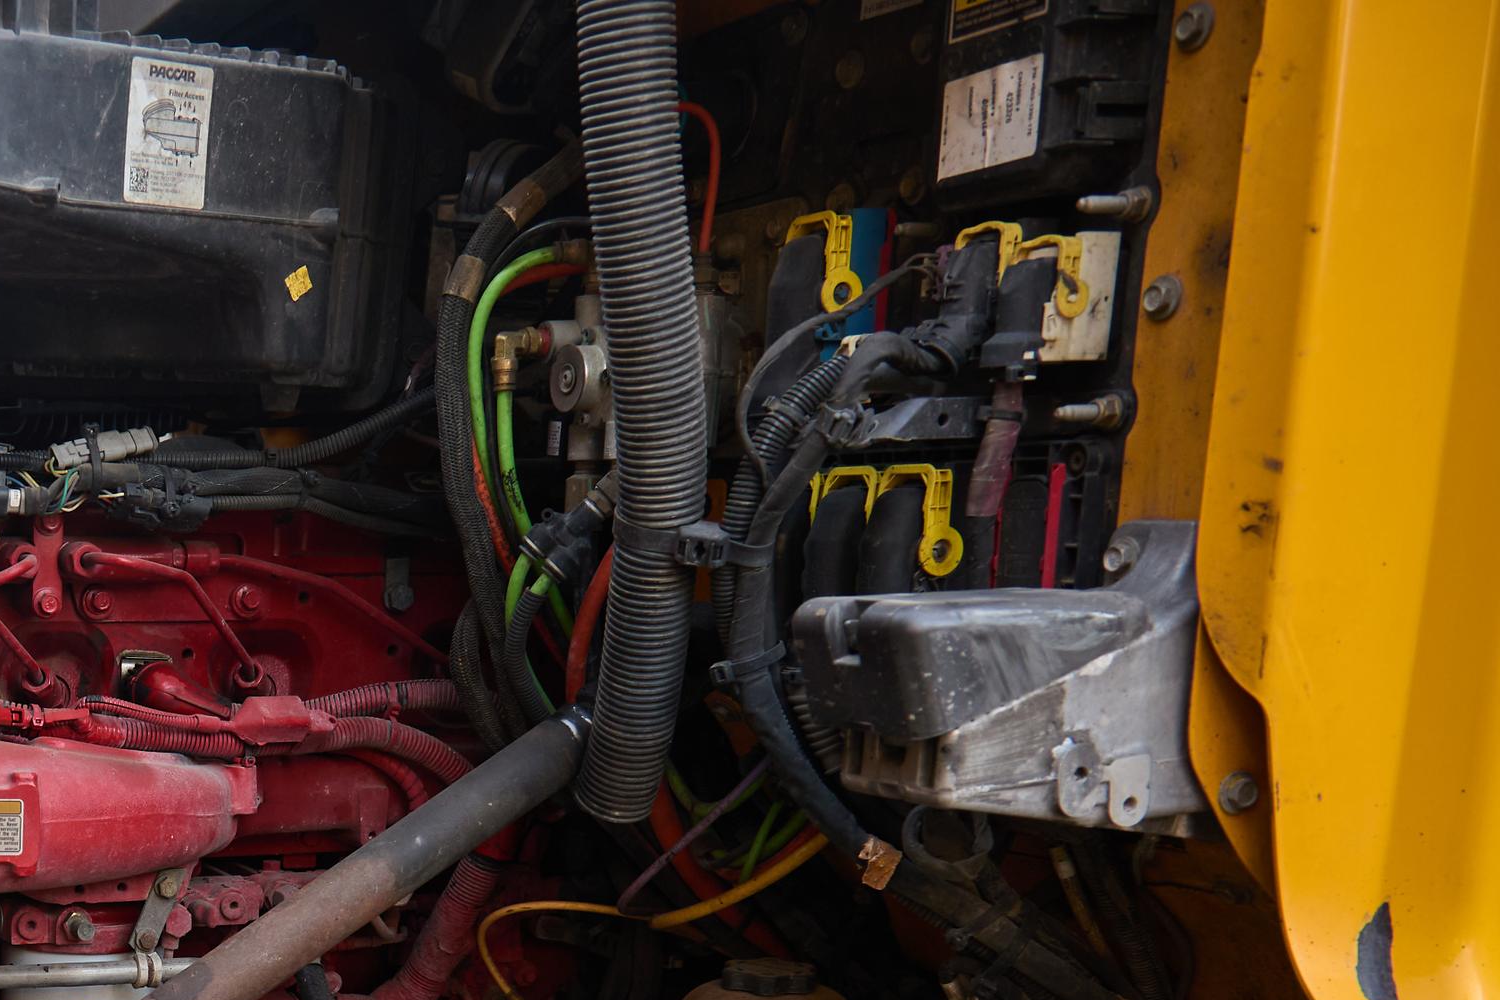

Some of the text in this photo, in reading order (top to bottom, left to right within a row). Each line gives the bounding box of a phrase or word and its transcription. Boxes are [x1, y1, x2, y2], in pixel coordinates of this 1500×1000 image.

[149, 65, 196, 83] PACCAR
[168, 89, 205, 100] Filter Access
